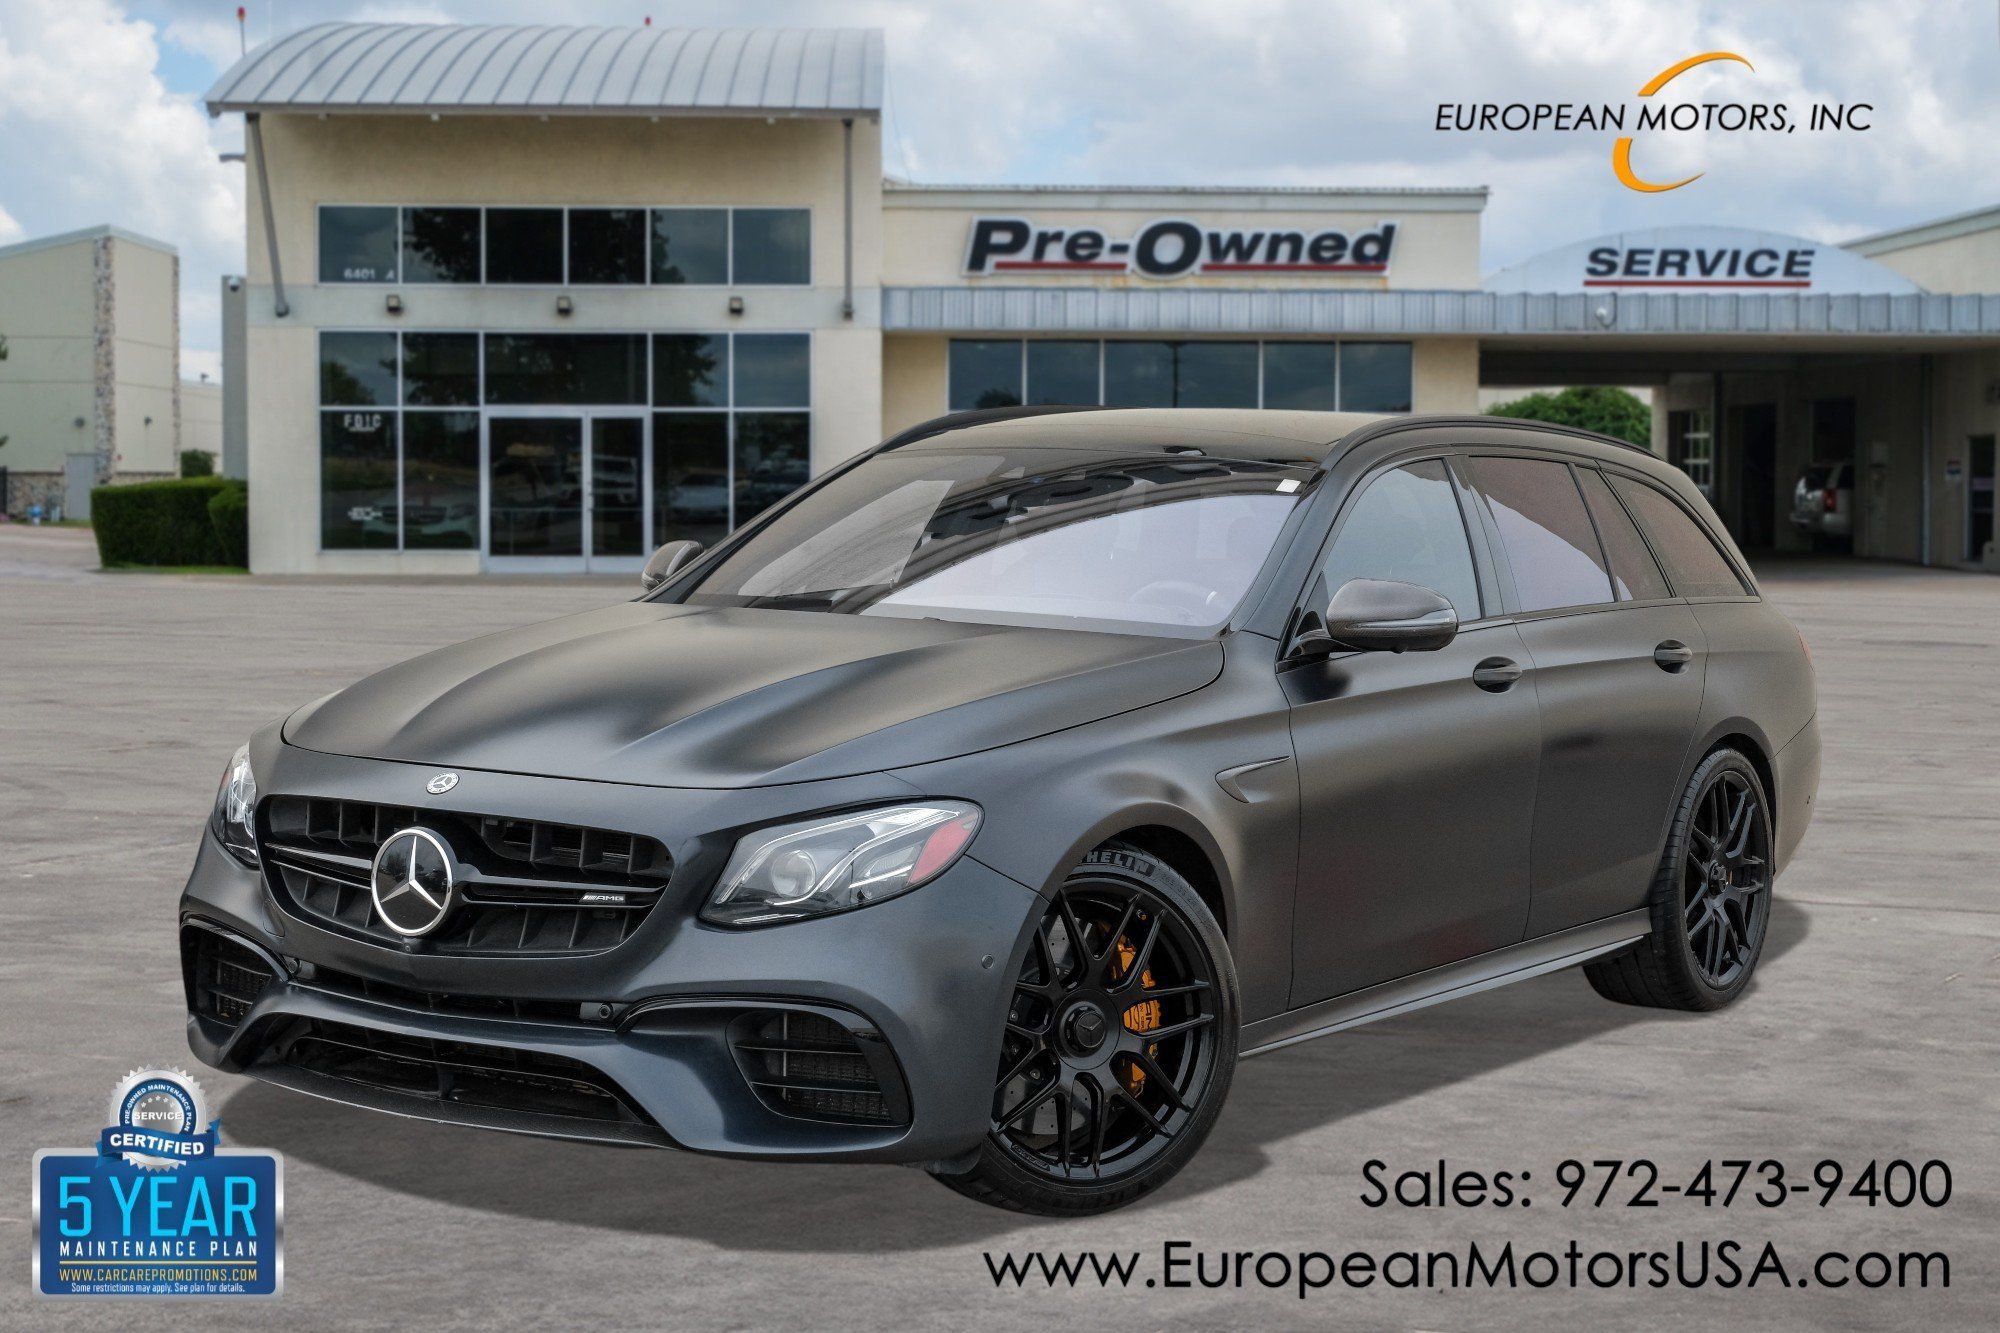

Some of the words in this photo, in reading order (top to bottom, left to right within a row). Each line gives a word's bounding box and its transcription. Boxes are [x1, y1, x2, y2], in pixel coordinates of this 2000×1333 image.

[967, 219, 1396, 276] Pre-Owned
[1585, 248, 1816, 278] SERVICE
[1087, 851, 1152, 874] HELIN
